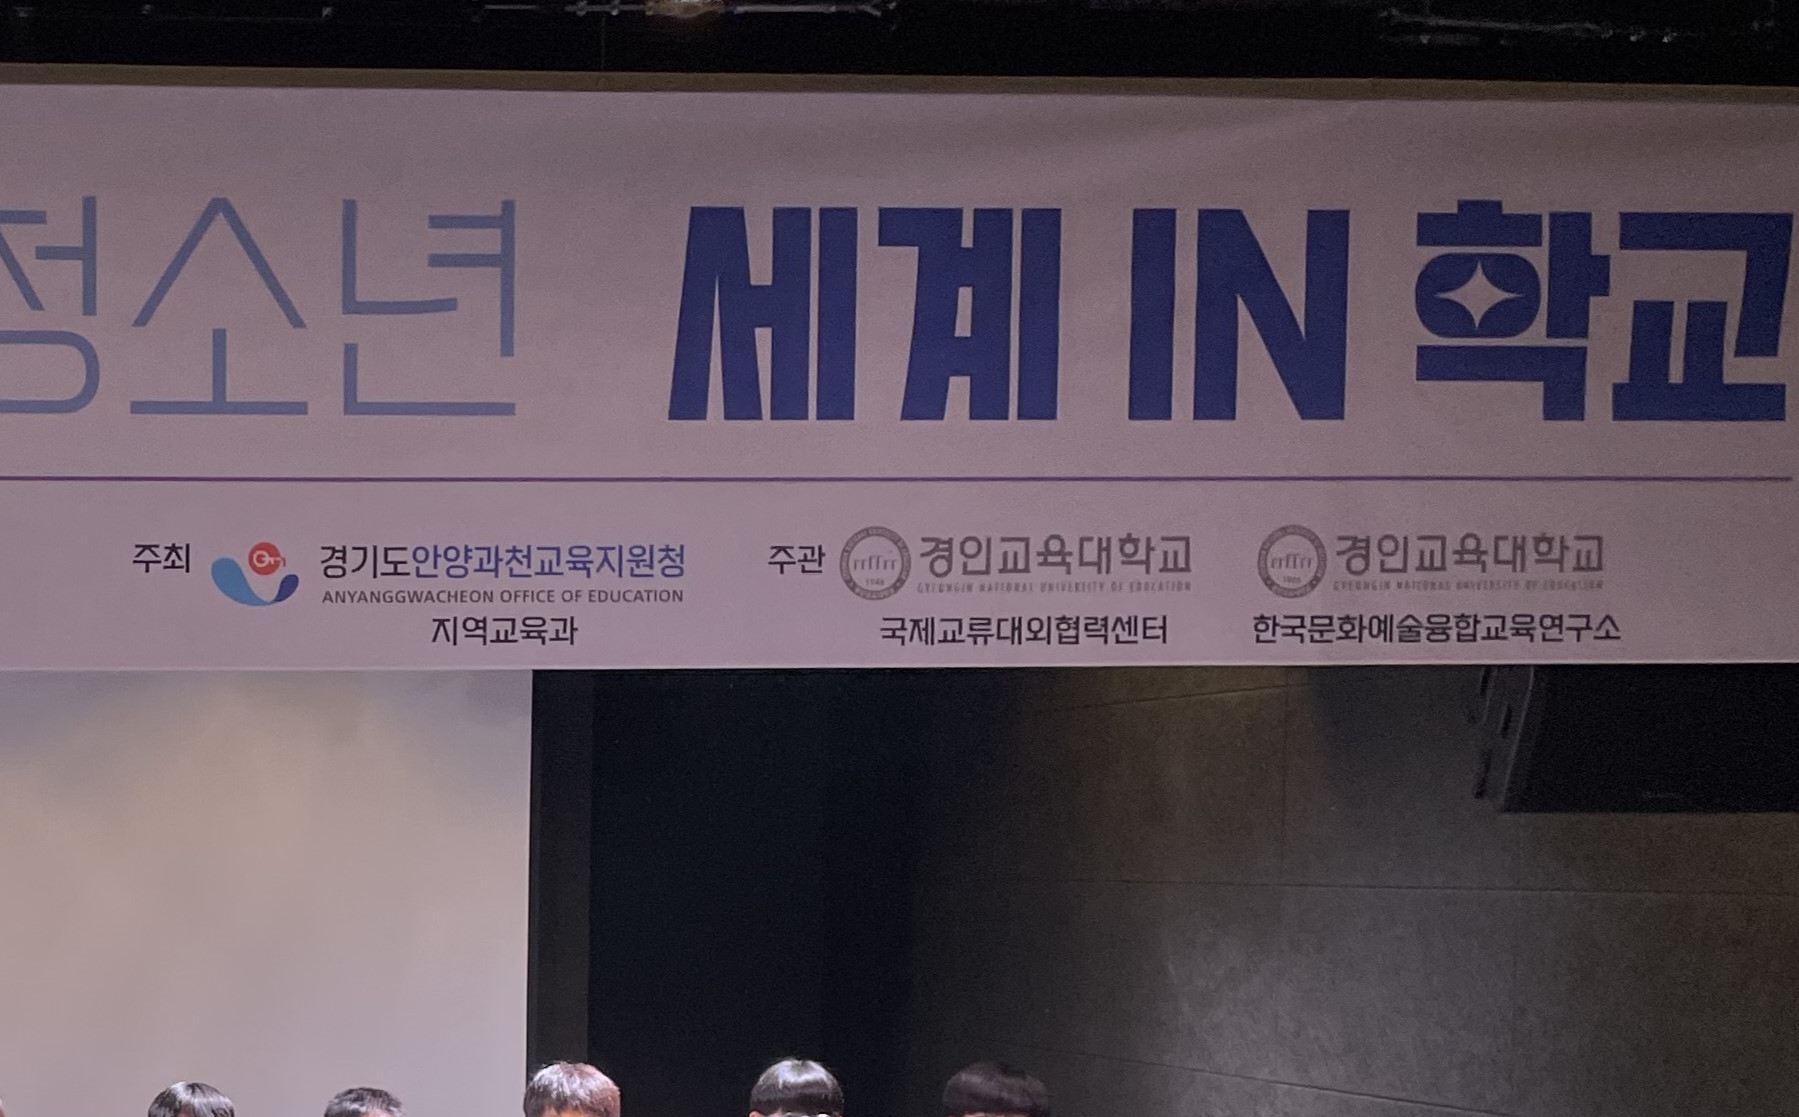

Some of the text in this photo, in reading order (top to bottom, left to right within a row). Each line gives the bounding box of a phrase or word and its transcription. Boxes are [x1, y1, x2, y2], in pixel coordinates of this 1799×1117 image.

[669, 206, 1062, 420] 세계
[1129, 208, 1350, 420] IN
[1416, 200, 1794, 421] 학교
[133, 543, 189, 573] 주최
[321, 545, 684, 578] 경기도안양과천교육지원청
[768, 545, 825, 574] 주관
[920, 533, 1191, 577] 경인교육대학교
[1337, 532, 1603, 575] 경인교육대학교
[322, 590, 683, 603] ANYANGGWACHEON OFFICE OF EDUCATION
[432, 616, 578, 646] 지역교육과
[881, 615, 1166, 646] 국제교류대외협력센터
[1254, 613, 1621, 643] 한국문화예술융합교육연구소
